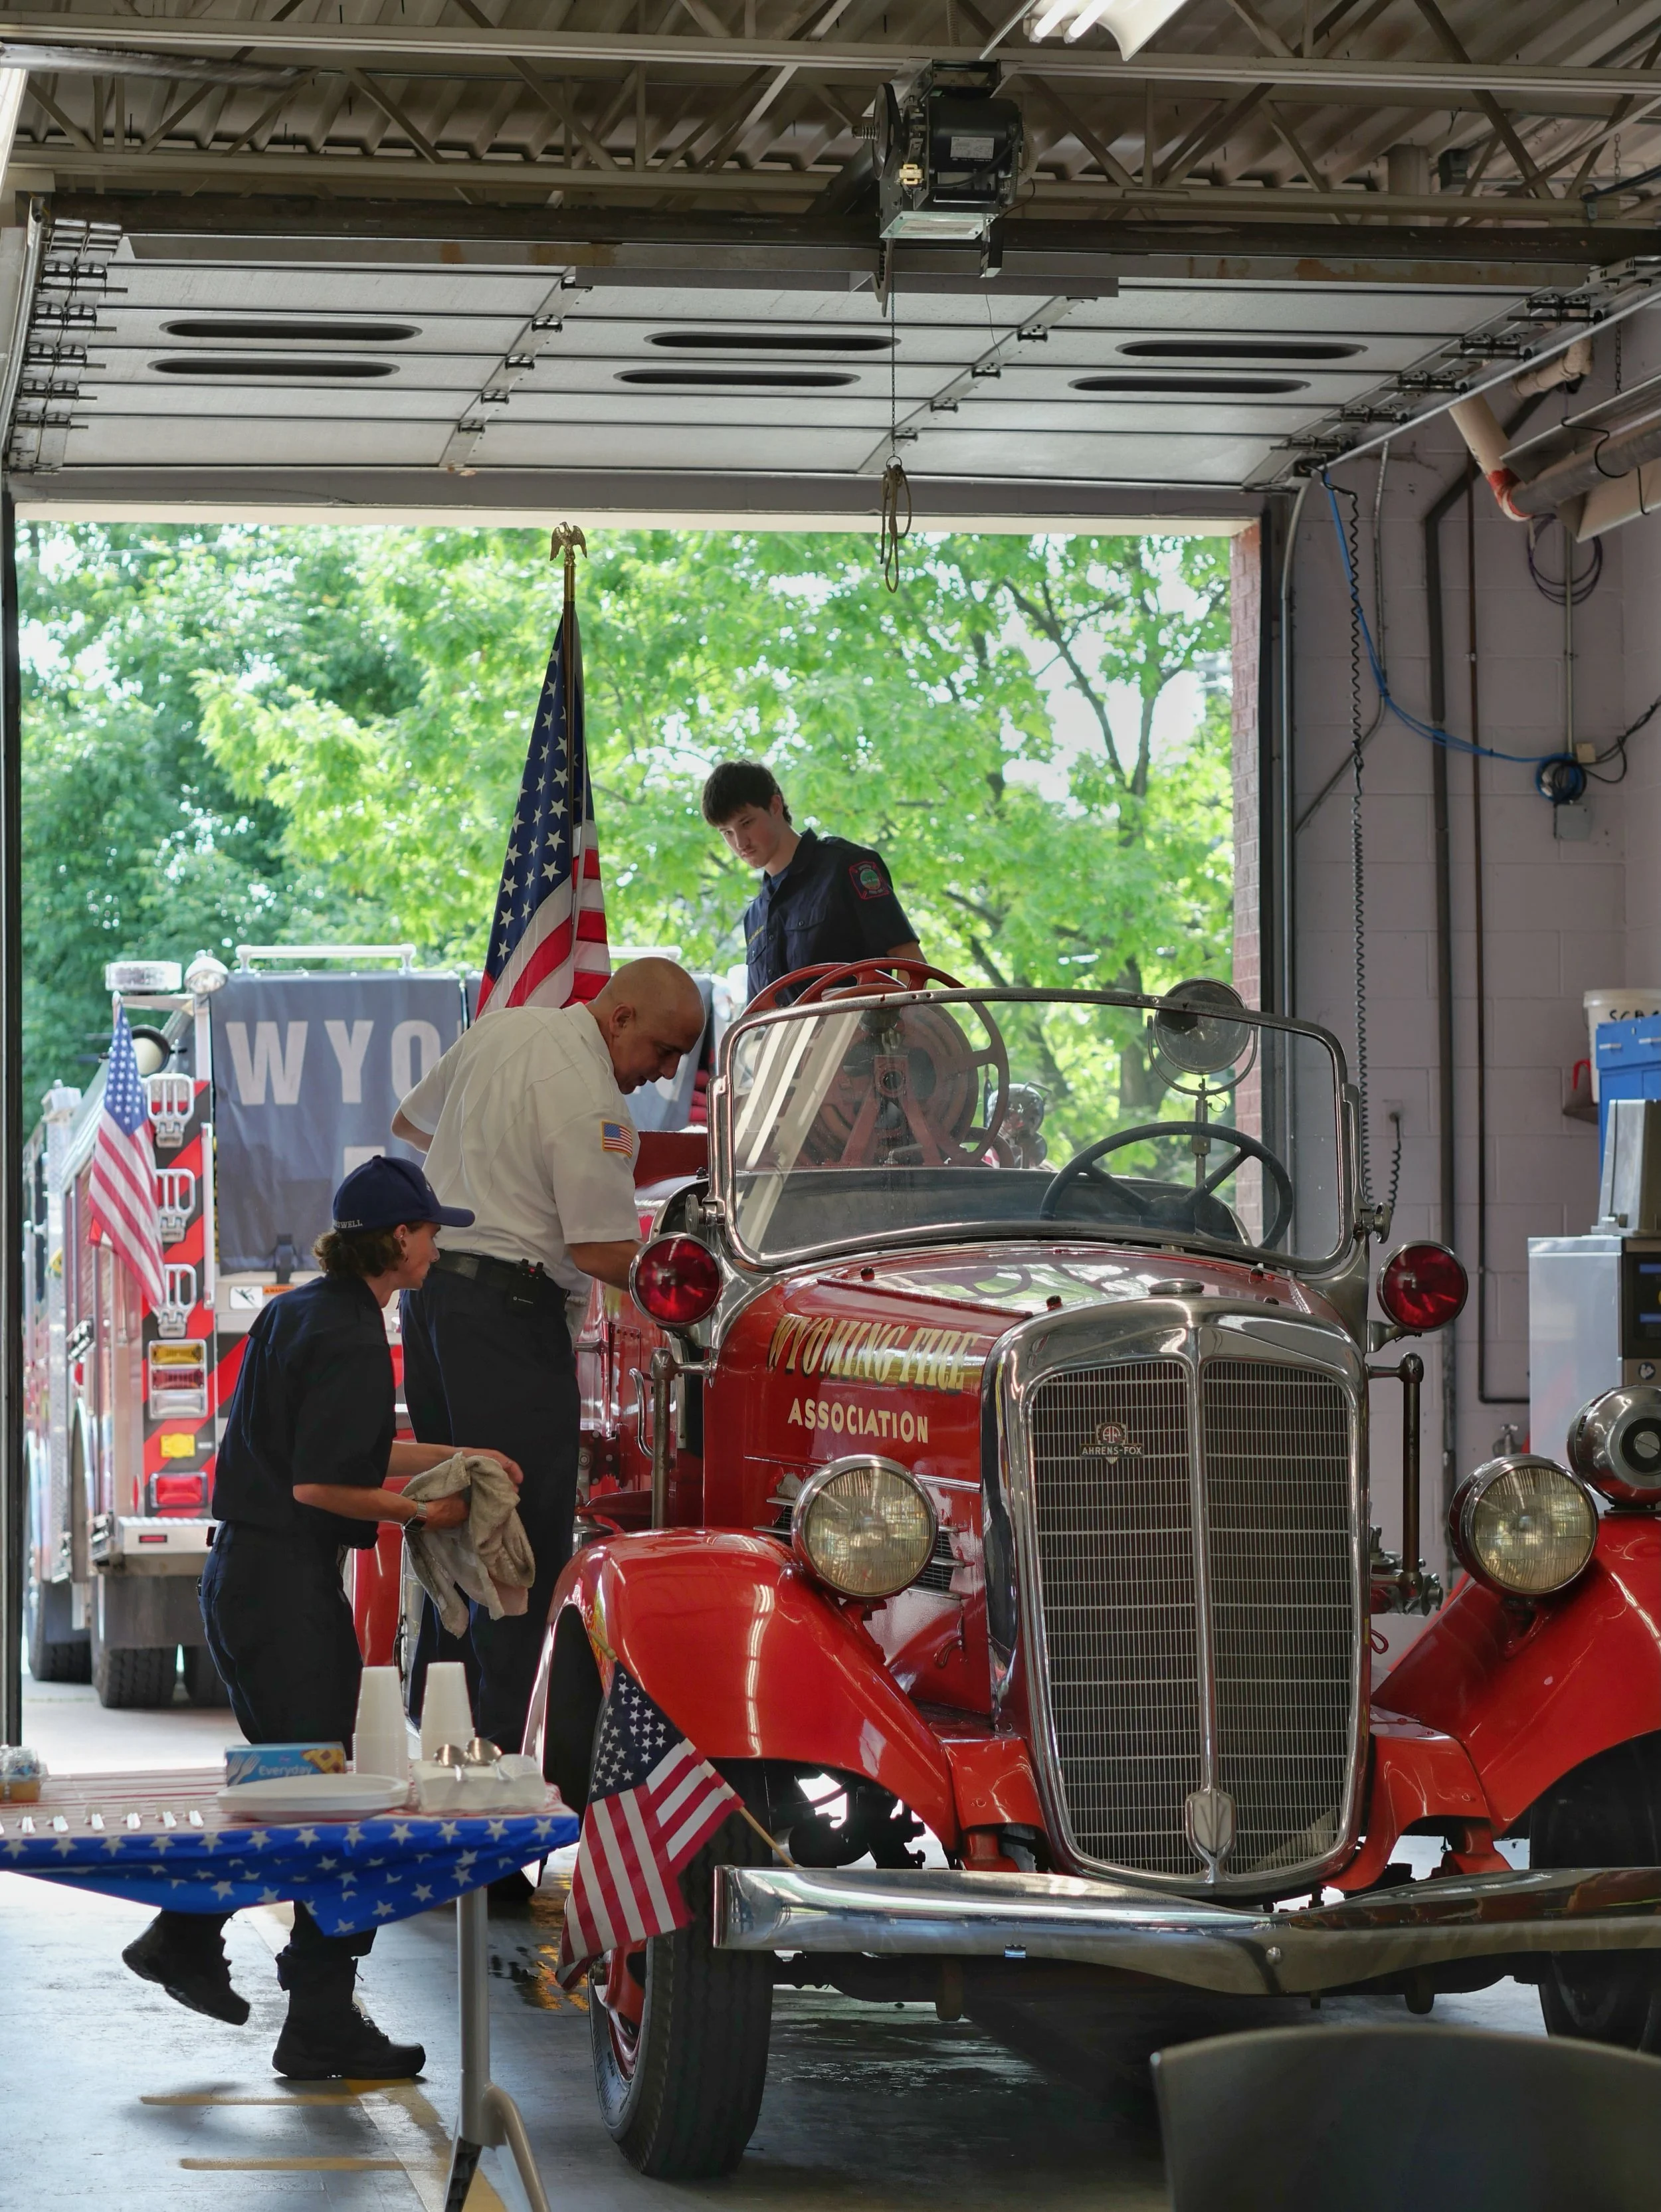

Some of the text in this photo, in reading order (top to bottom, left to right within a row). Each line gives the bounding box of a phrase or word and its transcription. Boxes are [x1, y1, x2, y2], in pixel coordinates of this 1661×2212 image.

[767, 1313, 981, 1390] WYOMING FIRE
[787, 1398, 928, 1444] ASSOCIATION
[1082, 1446, 1142, 1455] AHRENS-FOX
[258, 1764, 312, 1776] Everyday
